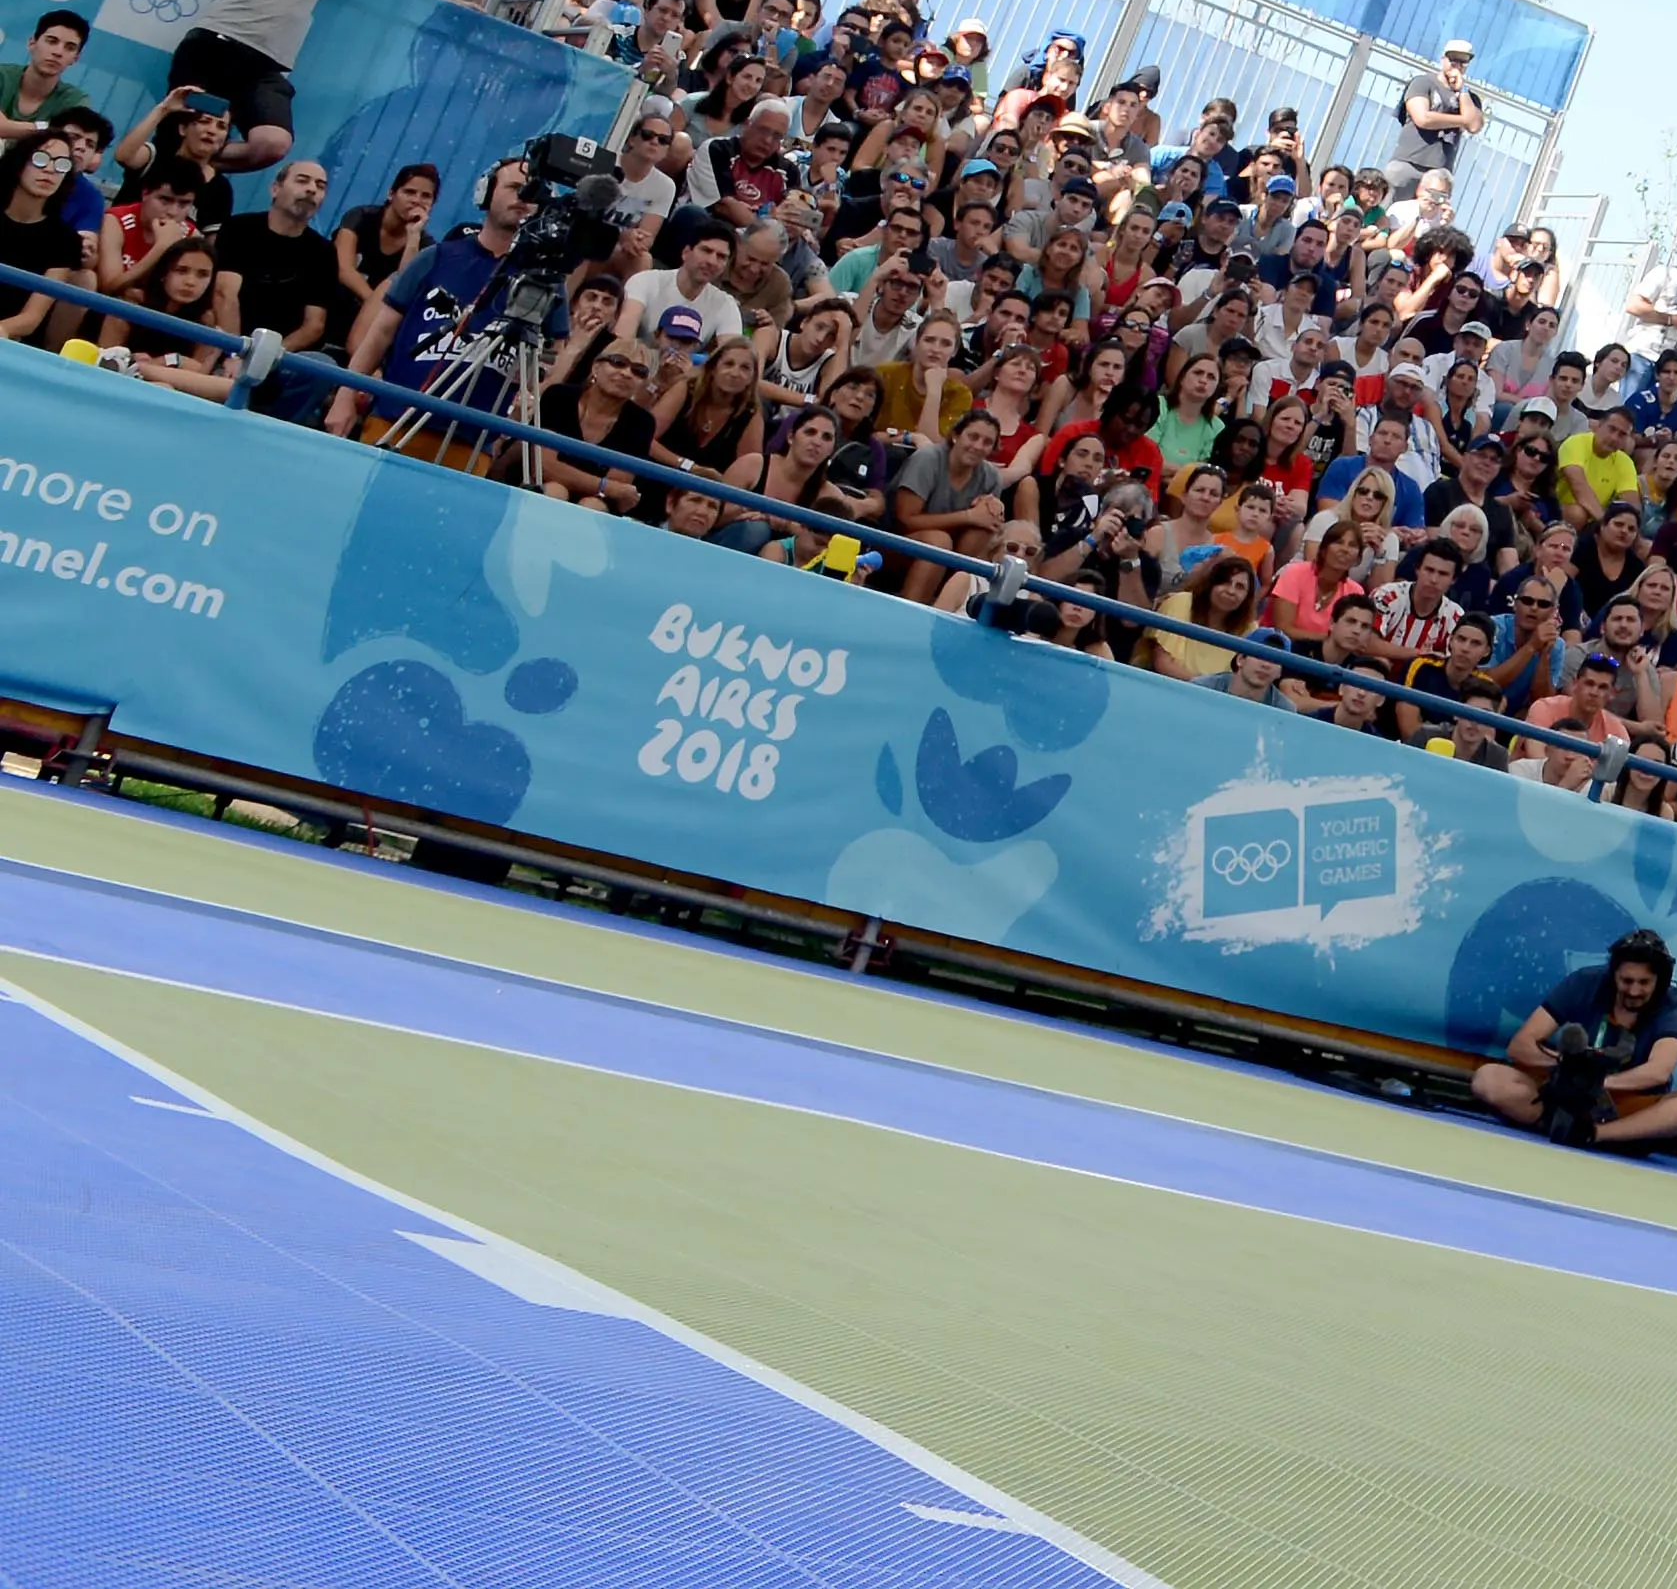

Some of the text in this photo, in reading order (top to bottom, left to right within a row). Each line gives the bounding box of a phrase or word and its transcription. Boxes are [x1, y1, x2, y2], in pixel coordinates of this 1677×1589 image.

[582, 142, 592, 154] 5
[148, 503, 218, 546] on
[648, 603, 849, 695] BUENOS
[656, 664, 806, 740] AIRES
[637, 718, 780, 801] 2018
[1320, 815, 1380, 838] YOUTH
[1312, 838, 1389, 863] OLYMPIC
[1320, 863, 1382, 885] GAMES
